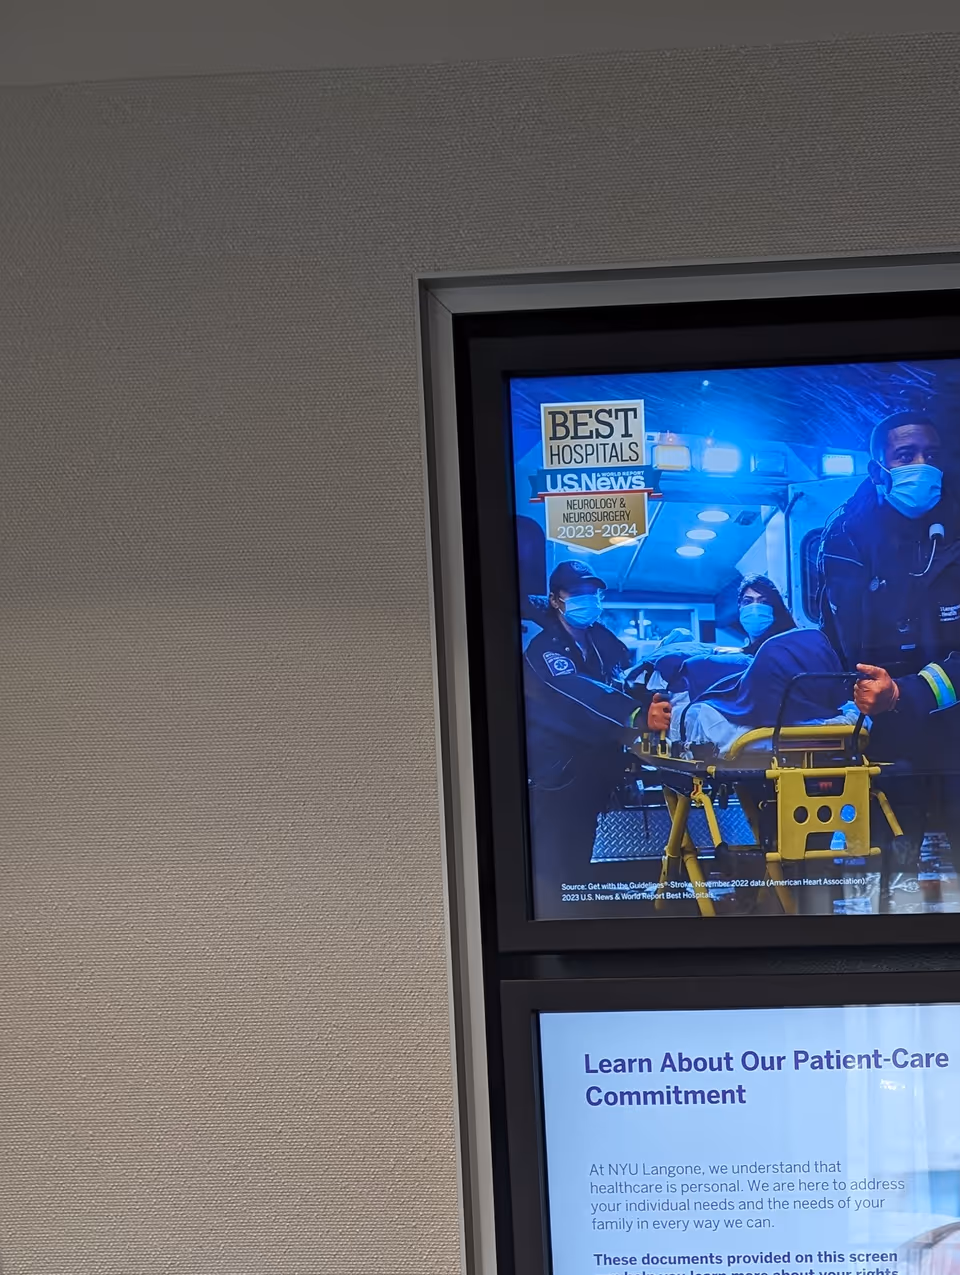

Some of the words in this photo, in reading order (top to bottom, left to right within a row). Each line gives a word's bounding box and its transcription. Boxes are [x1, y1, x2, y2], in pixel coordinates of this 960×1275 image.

[548, 408, 637, 440] BEST
[550, 442, 639, 465] HOSPITALS
[567, 498, 617, 510] NEUROLOGY
[620, 498, 626, 508] &
[563, 510, 631, 523] NEUROSURGERY
[557, 523, 637, 538] 2023-2024
[766, 878, 801, 886] (American
[642, 892, 664, 900] Report
[585, 1053, 652, 1073] Learn
[660, 1051, 733, 1072] About
[741, 1051, 786, 1071] Our
[794, 1048, 949, 1070] Patient-Care
[586, 1084, 746, 1106] Commitment
[589, 1163, 604, 1176] At
[608, 1163, 638, 1176] NYU
[643, 1162, 705, 1178] Langone,
[709, 1164, 728, 1174] we
[732, 1161, 810, 1174] understand
[814, 1161, 841, 1173] that
[590, 1181, 662, 1194] healthcare
[667, 1181, 677, 1194] is
[681, 1179, 743, 1195] personal.
[748, 1179, 769, 1192] We
[773, 1181, 795, 1192] are
[799, 1178, 829, 1191] here
[833, 1179, 846, 1191] to
[850, 1178, 905, 1190] address
[591, 1201, 621, 1214] your
[625, 1199, 689, 1212] individual
[694, 1198, 735, 1211] needs
[739, 1198, 764, 1211] and
[768, 1198, 789, 1210] the
[793, 1197, 834, 1209] needs
[838, 1196, 851, 1209] of
[854, 1197, 885, 1211] your
[592, 1218, 633, 1232] family
[637, 1218, 649, 1229] in
[653, 1219, 689, 1232] every
[693, 1218, 719, 1231] way
[724, 1218, 742, 1228] we
[747, 1218, 774, 1228] can.
[594, 1254, 637, 1266] These
[641, 1252, 723, 1265] documents
[727, 1252, 791, 1266] provided
[795, 1253, 813, 1263] on
[817, 1251, 845, 1263] this
[849, 1251, 897, 1263] screen
